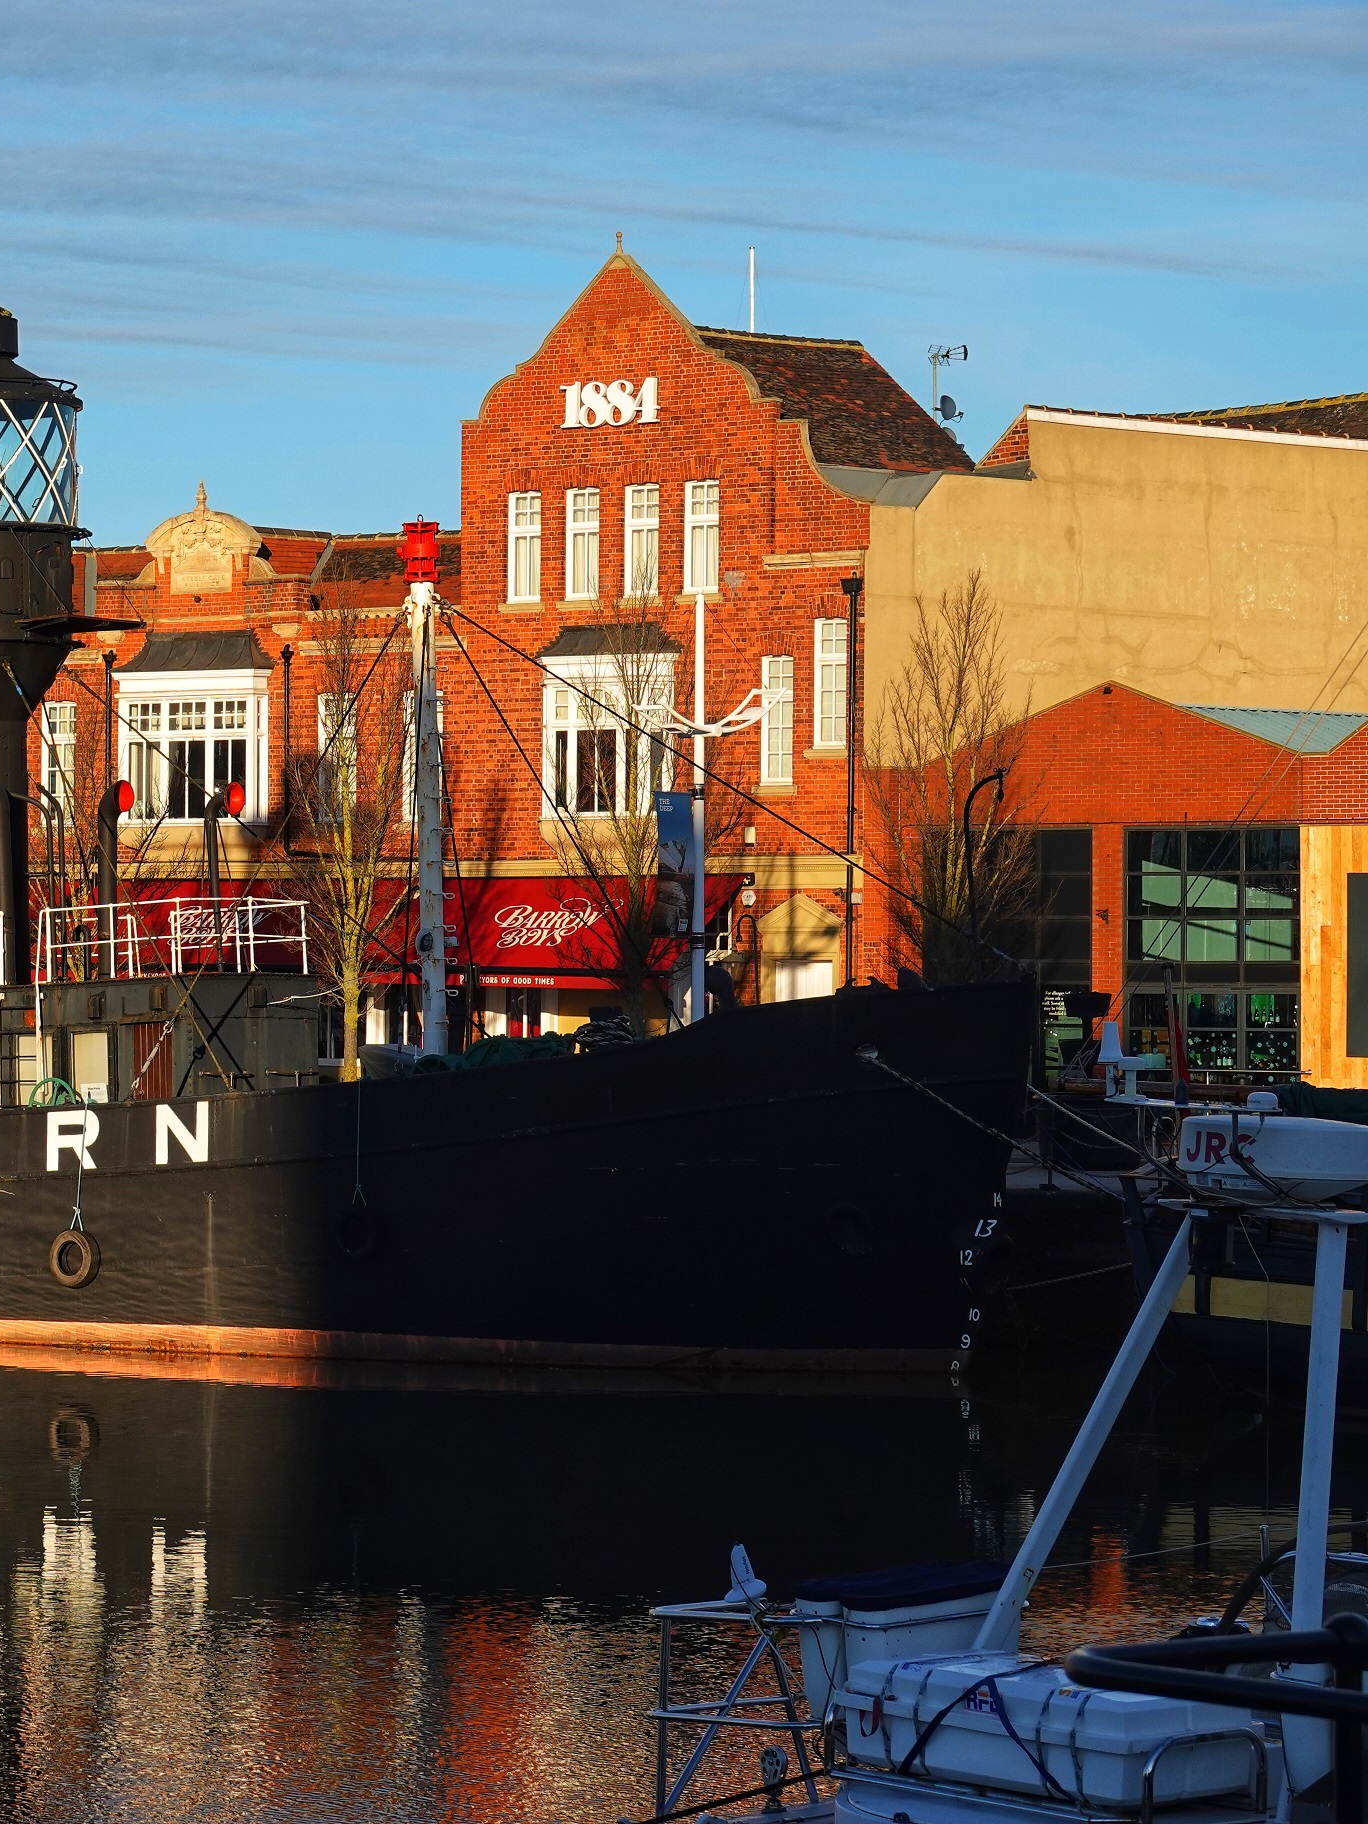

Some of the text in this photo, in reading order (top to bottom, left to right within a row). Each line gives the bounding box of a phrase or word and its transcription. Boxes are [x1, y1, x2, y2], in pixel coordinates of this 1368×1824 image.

[560, 377, 661, 428] 1884
[494, 897, 624, 929] BARROW
[496, 927, 563, 949] BOYS
[501, 976, 511, 984] OF
[513, 977, 532, 985] GOOD
[535, 977, 555, 985] TIMES
[1186, 1131, 1257, 1166] JRC
[993, 1192, 1002, 1207] 14
[974, 1220, 998, 1237] 13
[959, 1249, 973, 1266] 12
[968, 1308, 981, 1322] 10
[960, 1334, 971, 1349] 9
